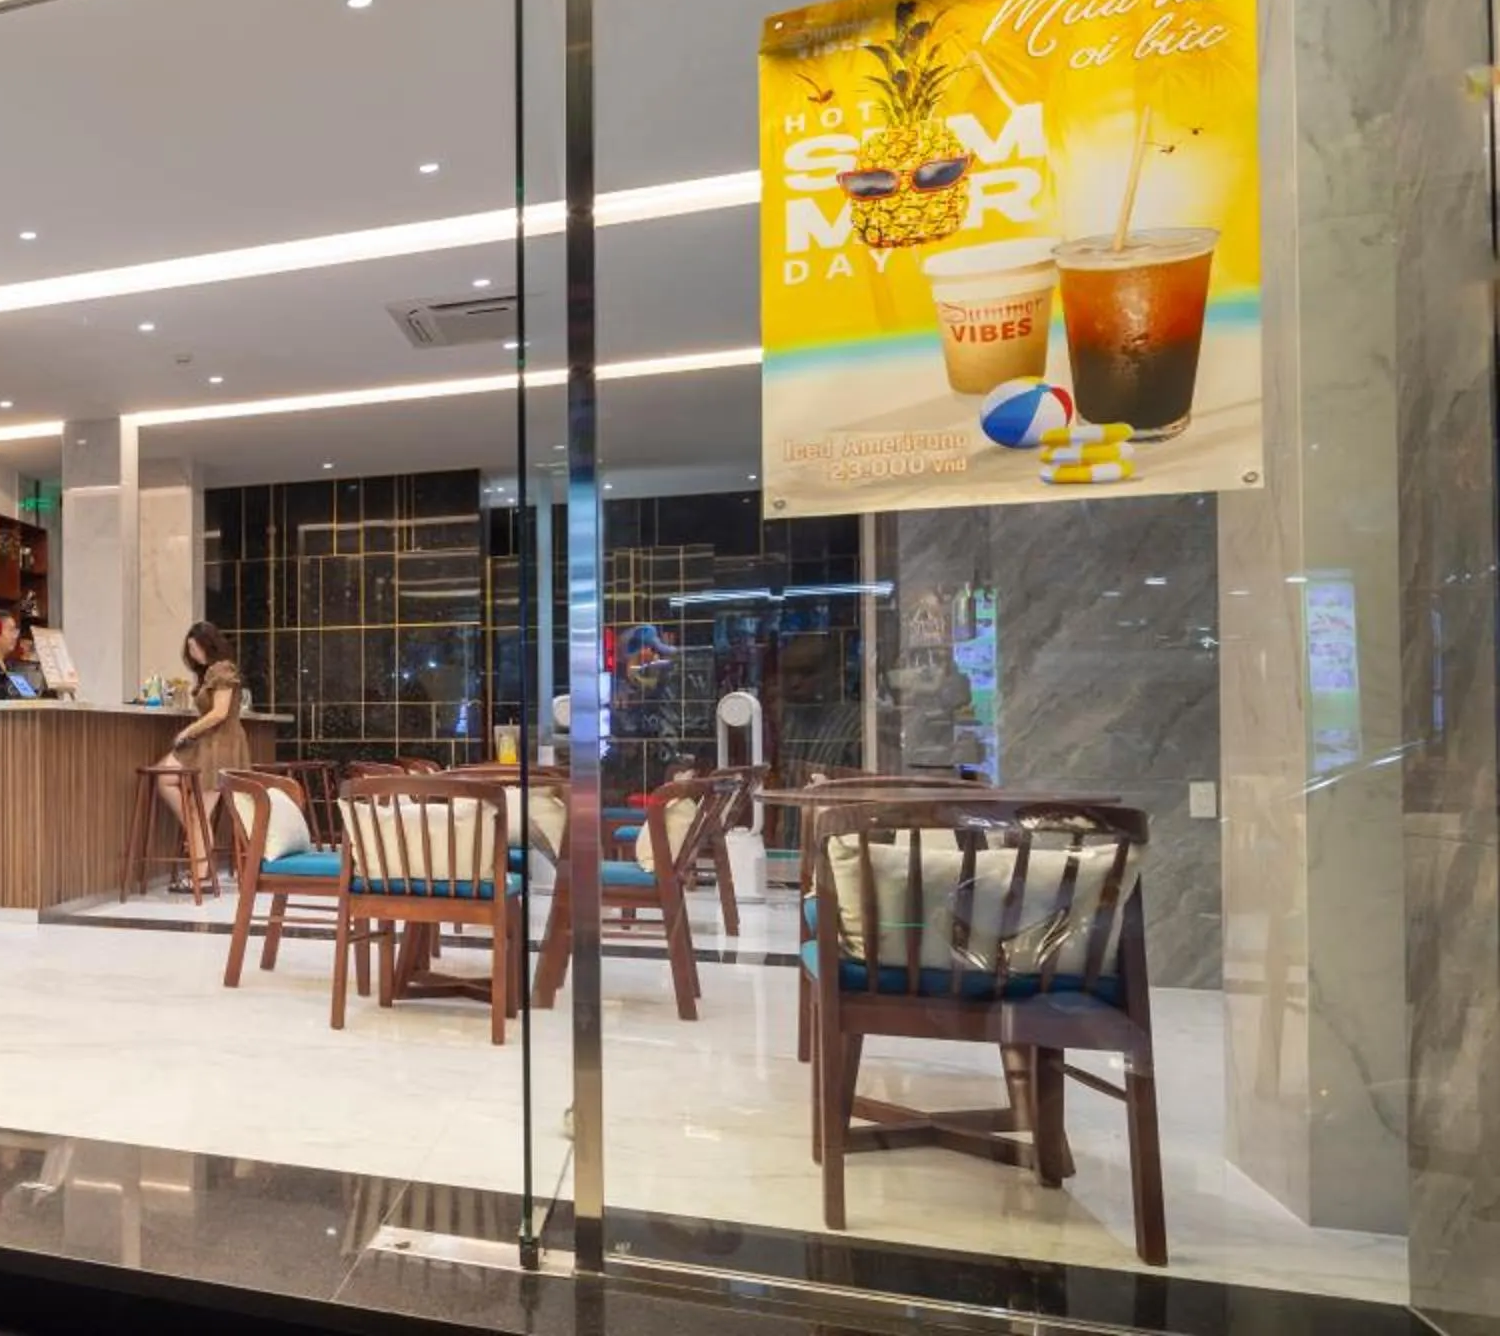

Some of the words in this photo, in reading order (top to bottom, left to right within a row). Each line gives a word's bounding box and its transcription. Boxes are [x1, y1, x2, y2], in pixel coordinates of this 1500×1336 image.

[1069, 35, 1122, 70] oi
[784, 101, 877, 134] HOT
[784, 103, 1046, 191] SM
[786, 167, 1043, 253] MR
[784, 246, 894, 285] DAY
[940, 297, 1044, 324] Summer
[950, 317, 1033, 343] VIBES
[783, 437, 833, 462] Iced
[841, 432, 968, 458] Americano
